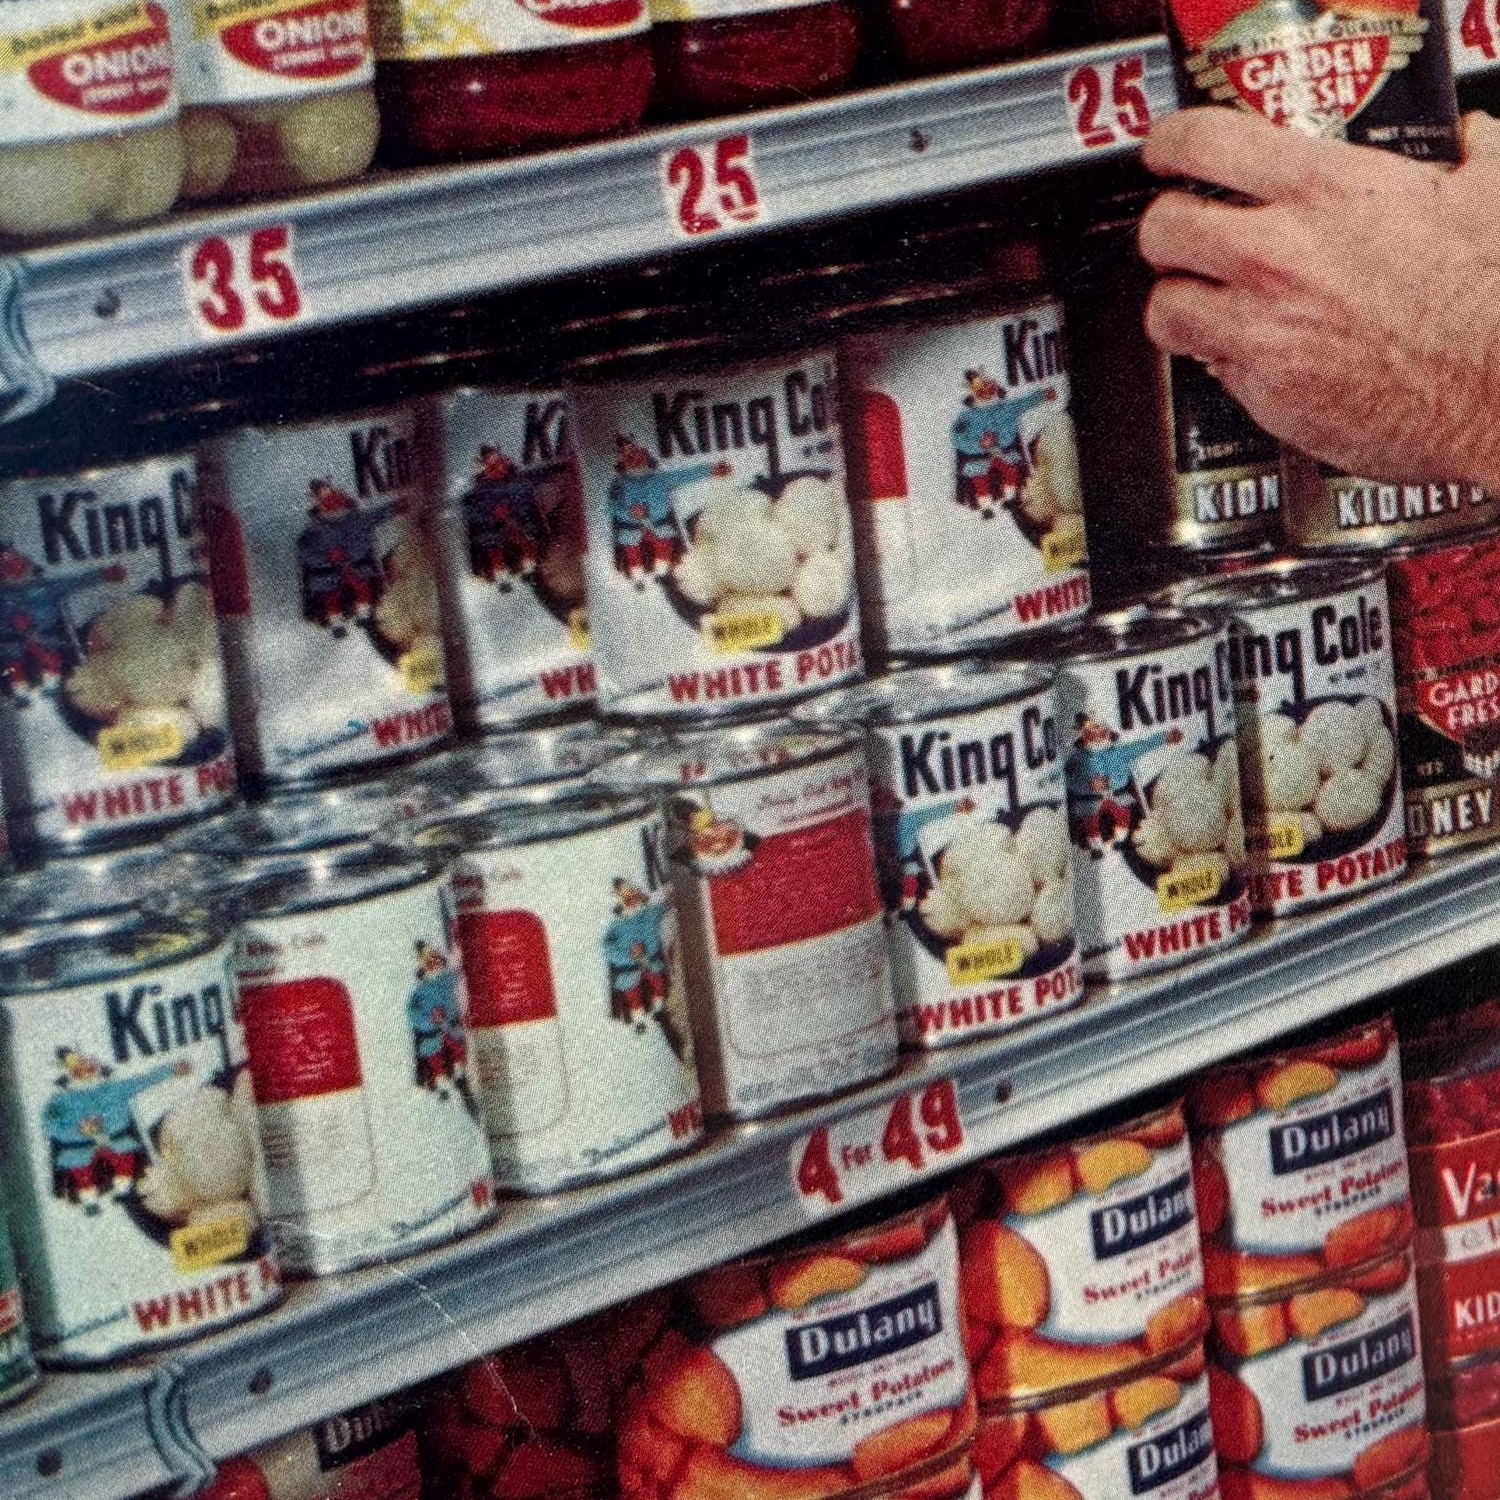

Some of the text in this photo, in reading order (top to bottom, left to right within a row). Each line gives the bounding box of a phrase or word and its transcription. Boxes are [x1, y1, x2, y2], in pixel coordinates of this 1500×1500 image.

[1241, 40, 1372, 91] GARDEN
[1067, 58, 1151, 148] 25
[667, 134, 759, 237] 25
[190, 225, 301, 334] 35
[652, 388, 782, 476] King
[1338, 482, 1460, 529] KIDNEY
[38, 489, 172, 595] King
[1312, 595, 1383, 667] Cole
[669, 661, 783, 705] WHITE
[1116, 664, 1216, 743] King
[62, 774, 187, 826] WHITE
[900, 729, 1018, 822] King
[957, 943, 1014, 971] WHOLE
[1124, 916, 1223, 963] WHITE
[103, 981, 233, 1095] King
[914, 985, 1024, 1035] WHITE
[796, 1078, 965, 1204] 4 For 49
[1281, 1100, 1390, 1161] Dulany
[1260, 1184, 1332, 1220] Sweet
[132, 1271, 251, 1334] WHITE
[1082, 1268, 1152, 1307] Sweet
[799, 1298, 937, 1366] Dulany
[1312, 1325, 1413, 1390] Dulany
[777, 1389, 864, 1426] Sweet
[1294, 1407, 1364, 1444] Sweet
